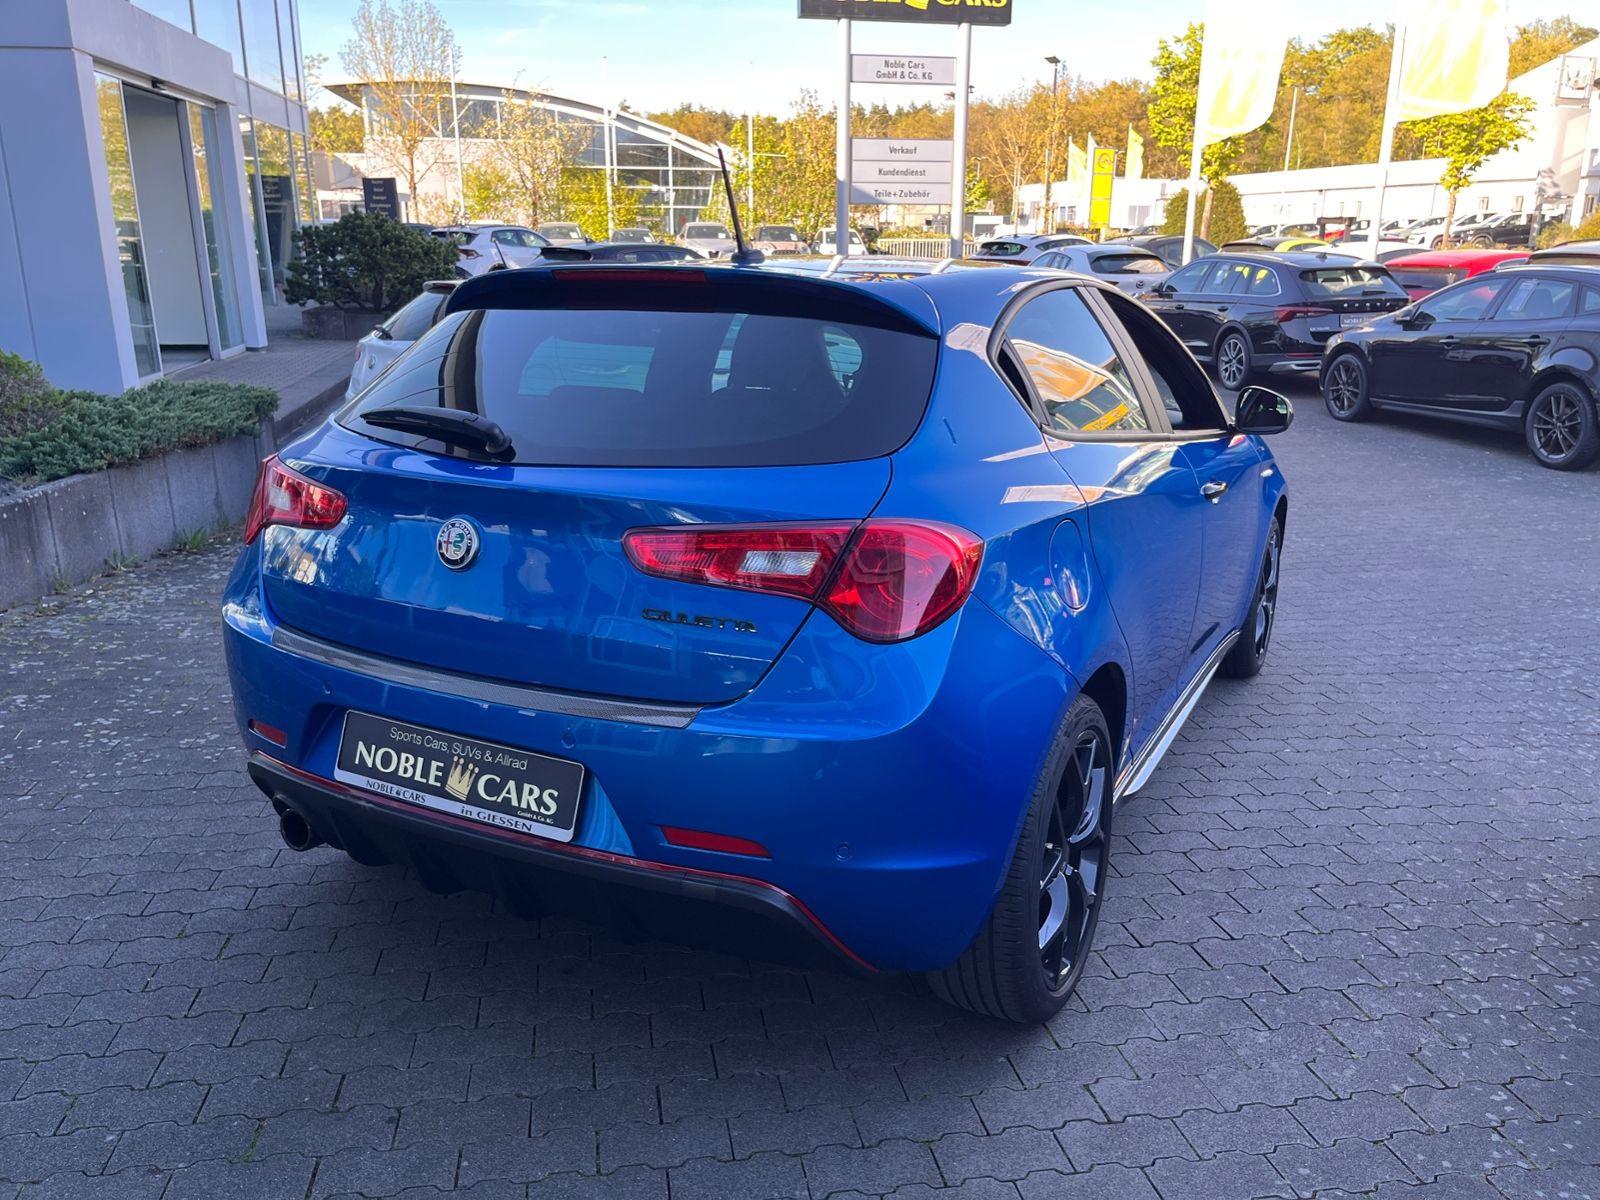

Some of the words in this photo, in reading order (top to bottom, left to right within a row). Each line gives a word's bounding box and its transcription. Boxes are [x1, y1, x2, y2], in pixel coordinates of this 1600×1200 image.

[883, 59, 905, 69] Noble
[907, 60, 925, 70] Cars
[875, 70, 898, 79] GmbH
[899, 70, 906, 80] &
[908, 71, 920, 80] Co.
[922, 71, 933, 81] KG
[888, 145, 917, 155] Verkauf
[878, 167, 926, 177] Kundendienst
[390, 726, 422, 745] Sports
[424, 735, 450, 754] Cars,
[451, 742, 482, 760] SUVs
[484, 750, 493, 762] &
[494, 752, 528, 770] Allrad
[354, 740, 445, 787] NOBLE
[477, 773, 559, 816] CARS
[366, 780, 395, 795] NOBLE
[402, 789, 426, 804] CARS
[460, 806, 473, 817] in
[476, 811, 533, 832] GIESSEN
